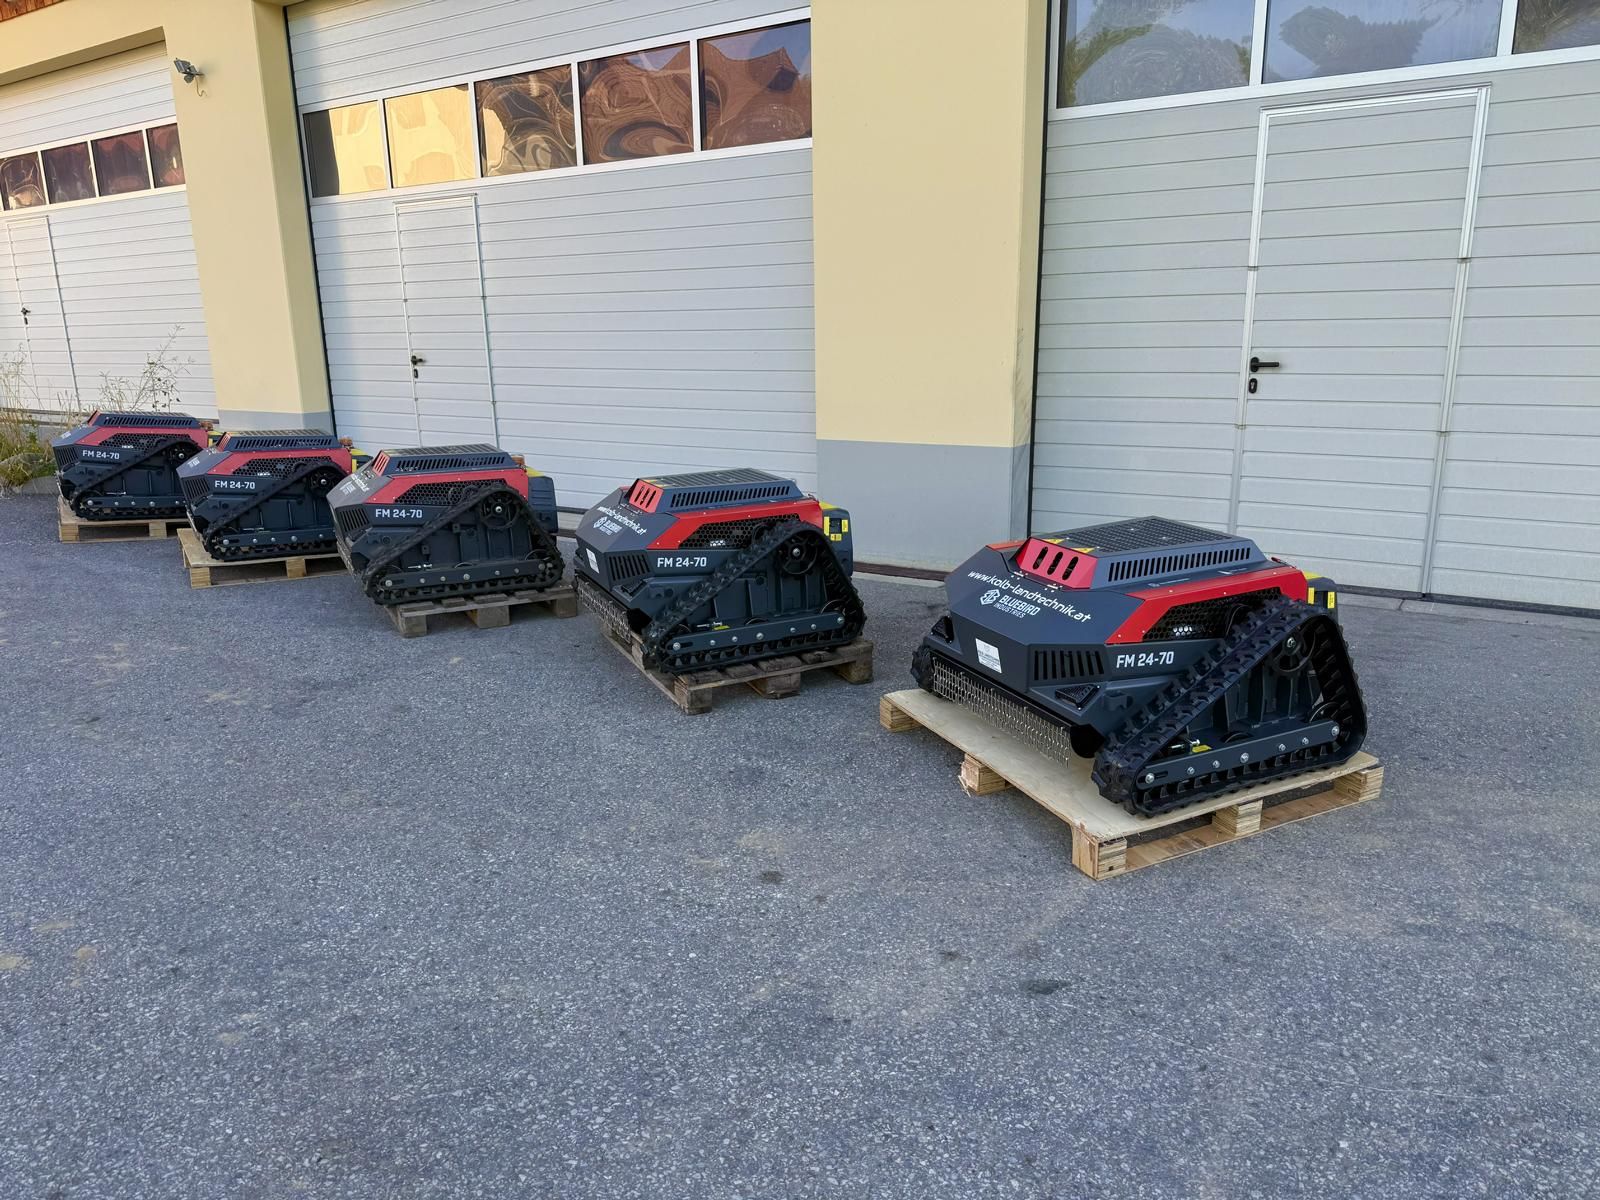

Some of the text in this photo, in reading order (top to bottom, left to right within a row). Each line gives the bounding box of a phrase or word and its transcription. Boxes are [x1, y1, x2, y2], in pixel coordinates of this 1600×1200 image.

[82, 450, 120, 460] FM 24-70
[214, 480, 256, 490] FM 24-70
[375, 508, 423, 519] FM 24-70
[656, 556, 707, 568] FM 24-70
[967, 570, 1092, 623] www.kolb-landtechnik.at
[993, 602, 1027, 619] INDUSTRIES
[998, 594, 1041, 617] BLUEBIRD
[1116, 651, 1175, 669] FM 24-70
